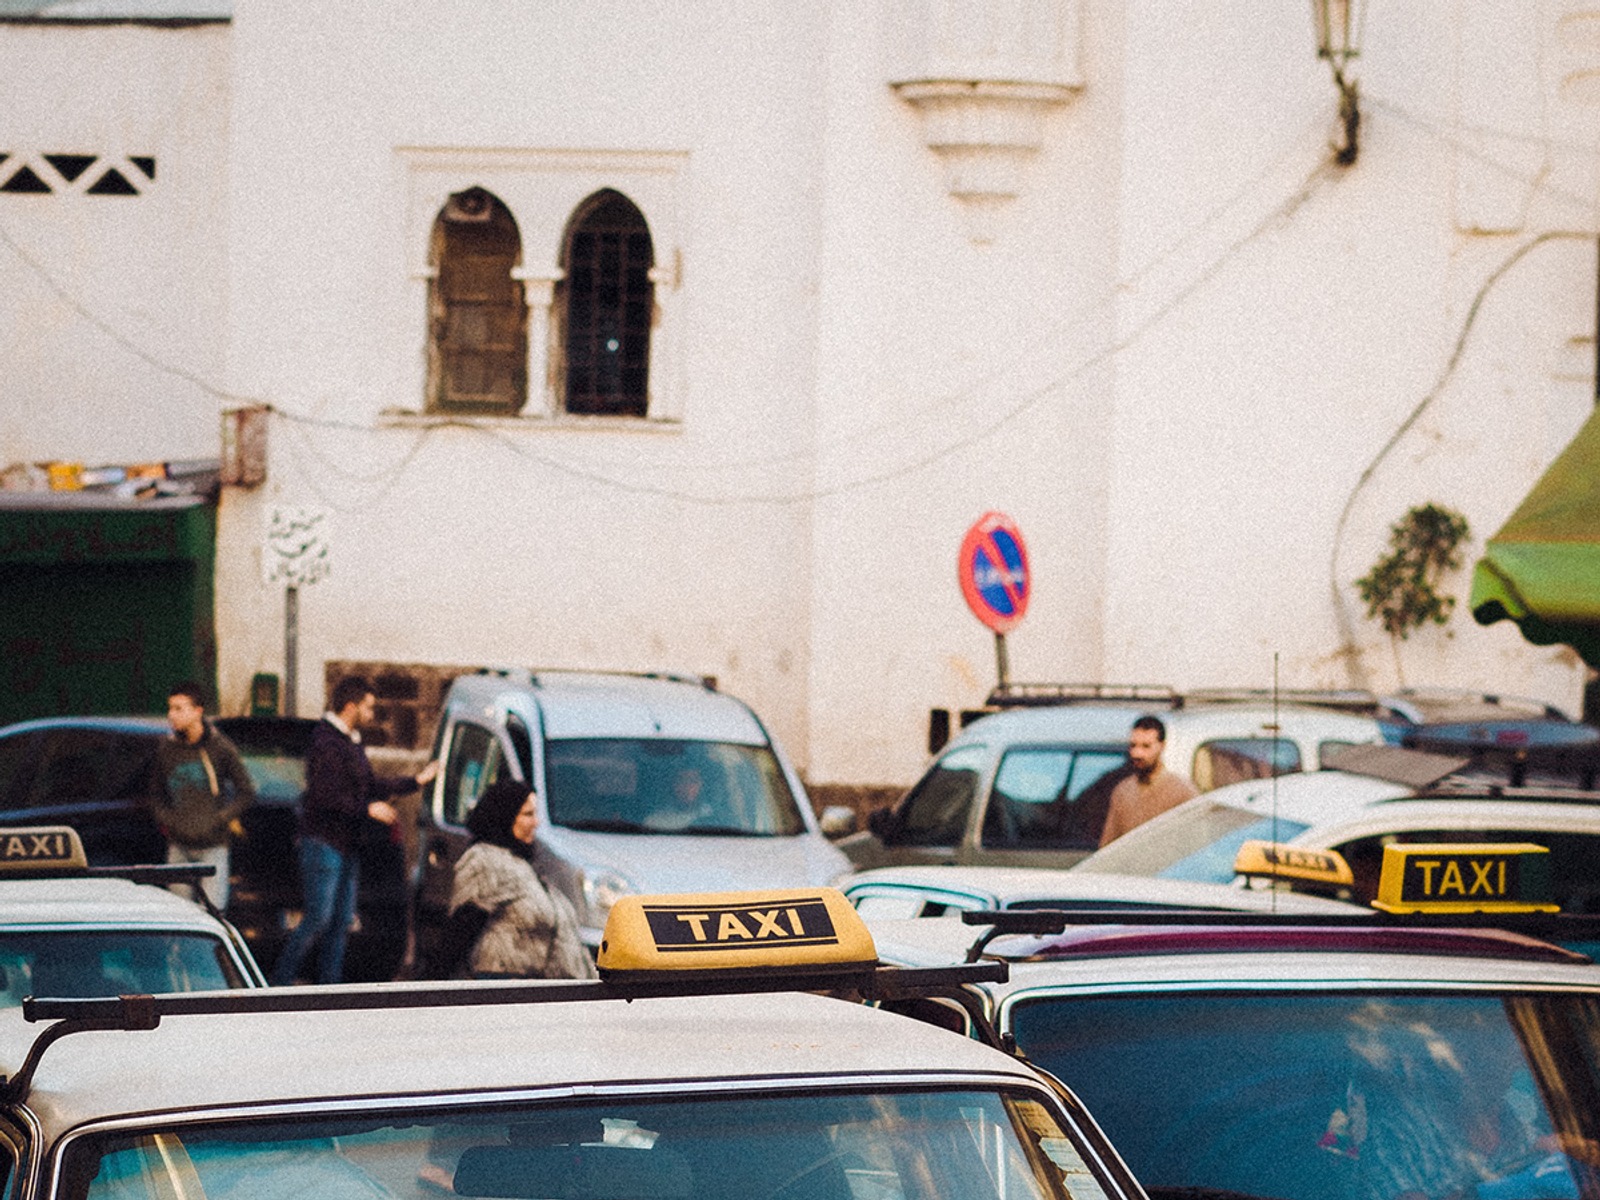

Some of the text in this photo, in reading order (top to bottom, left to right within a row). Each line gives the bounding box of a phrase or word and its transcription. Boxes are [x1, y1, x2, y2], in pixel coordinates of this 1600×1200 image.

[0, 834, 65, 856] AXI
[1415, 860, 1507, 896] TAXI
[676, 908, 806, 942] TAXI
